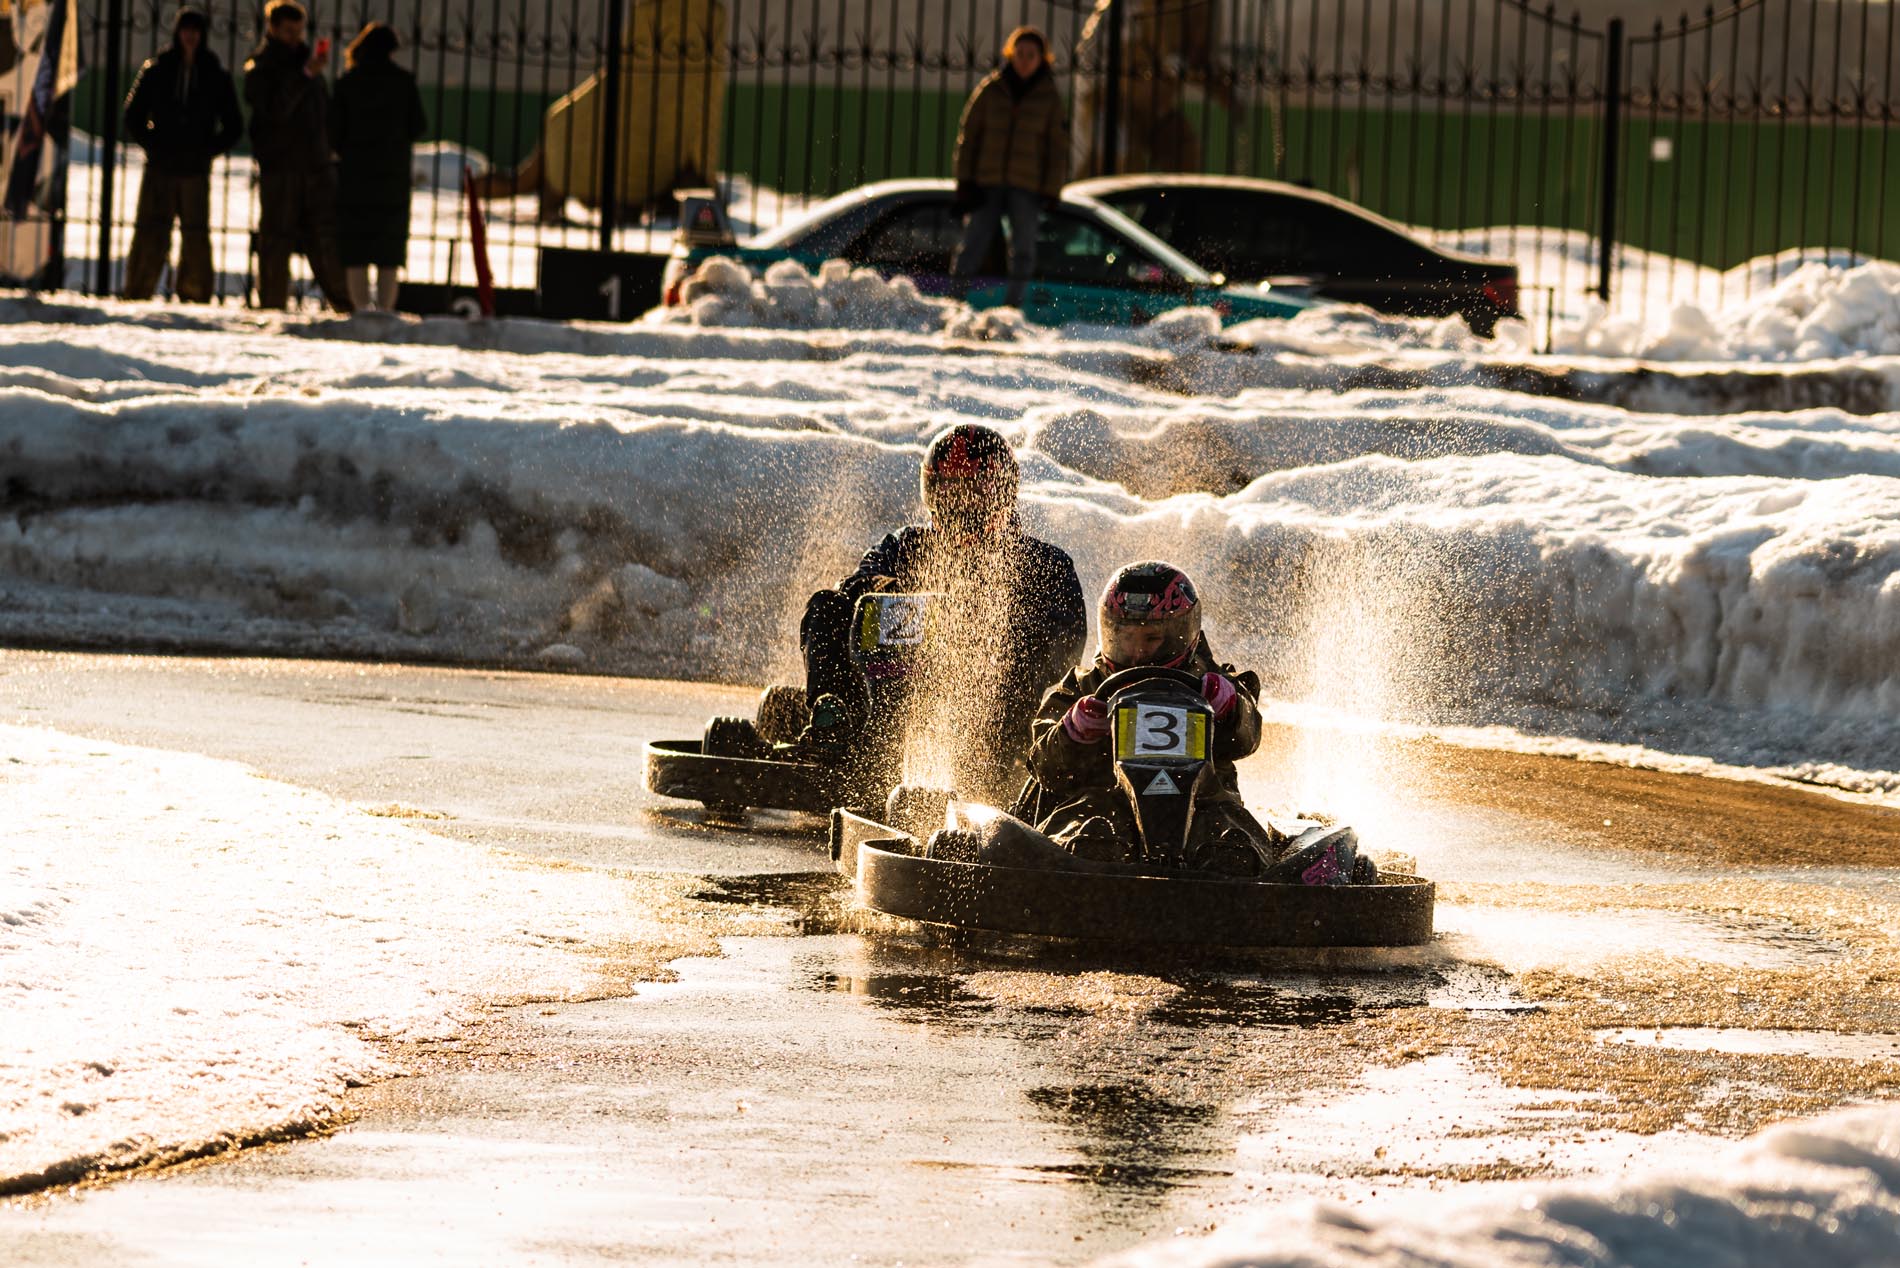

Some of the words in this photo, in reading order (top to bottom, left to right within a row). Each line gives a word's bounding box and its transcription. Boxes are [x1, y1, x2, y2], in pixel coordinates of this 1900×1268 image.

[600, 275, 621, 320] 1
[886, 602, 917, 639] 2
[1141, 711, 1180, 751] 3
